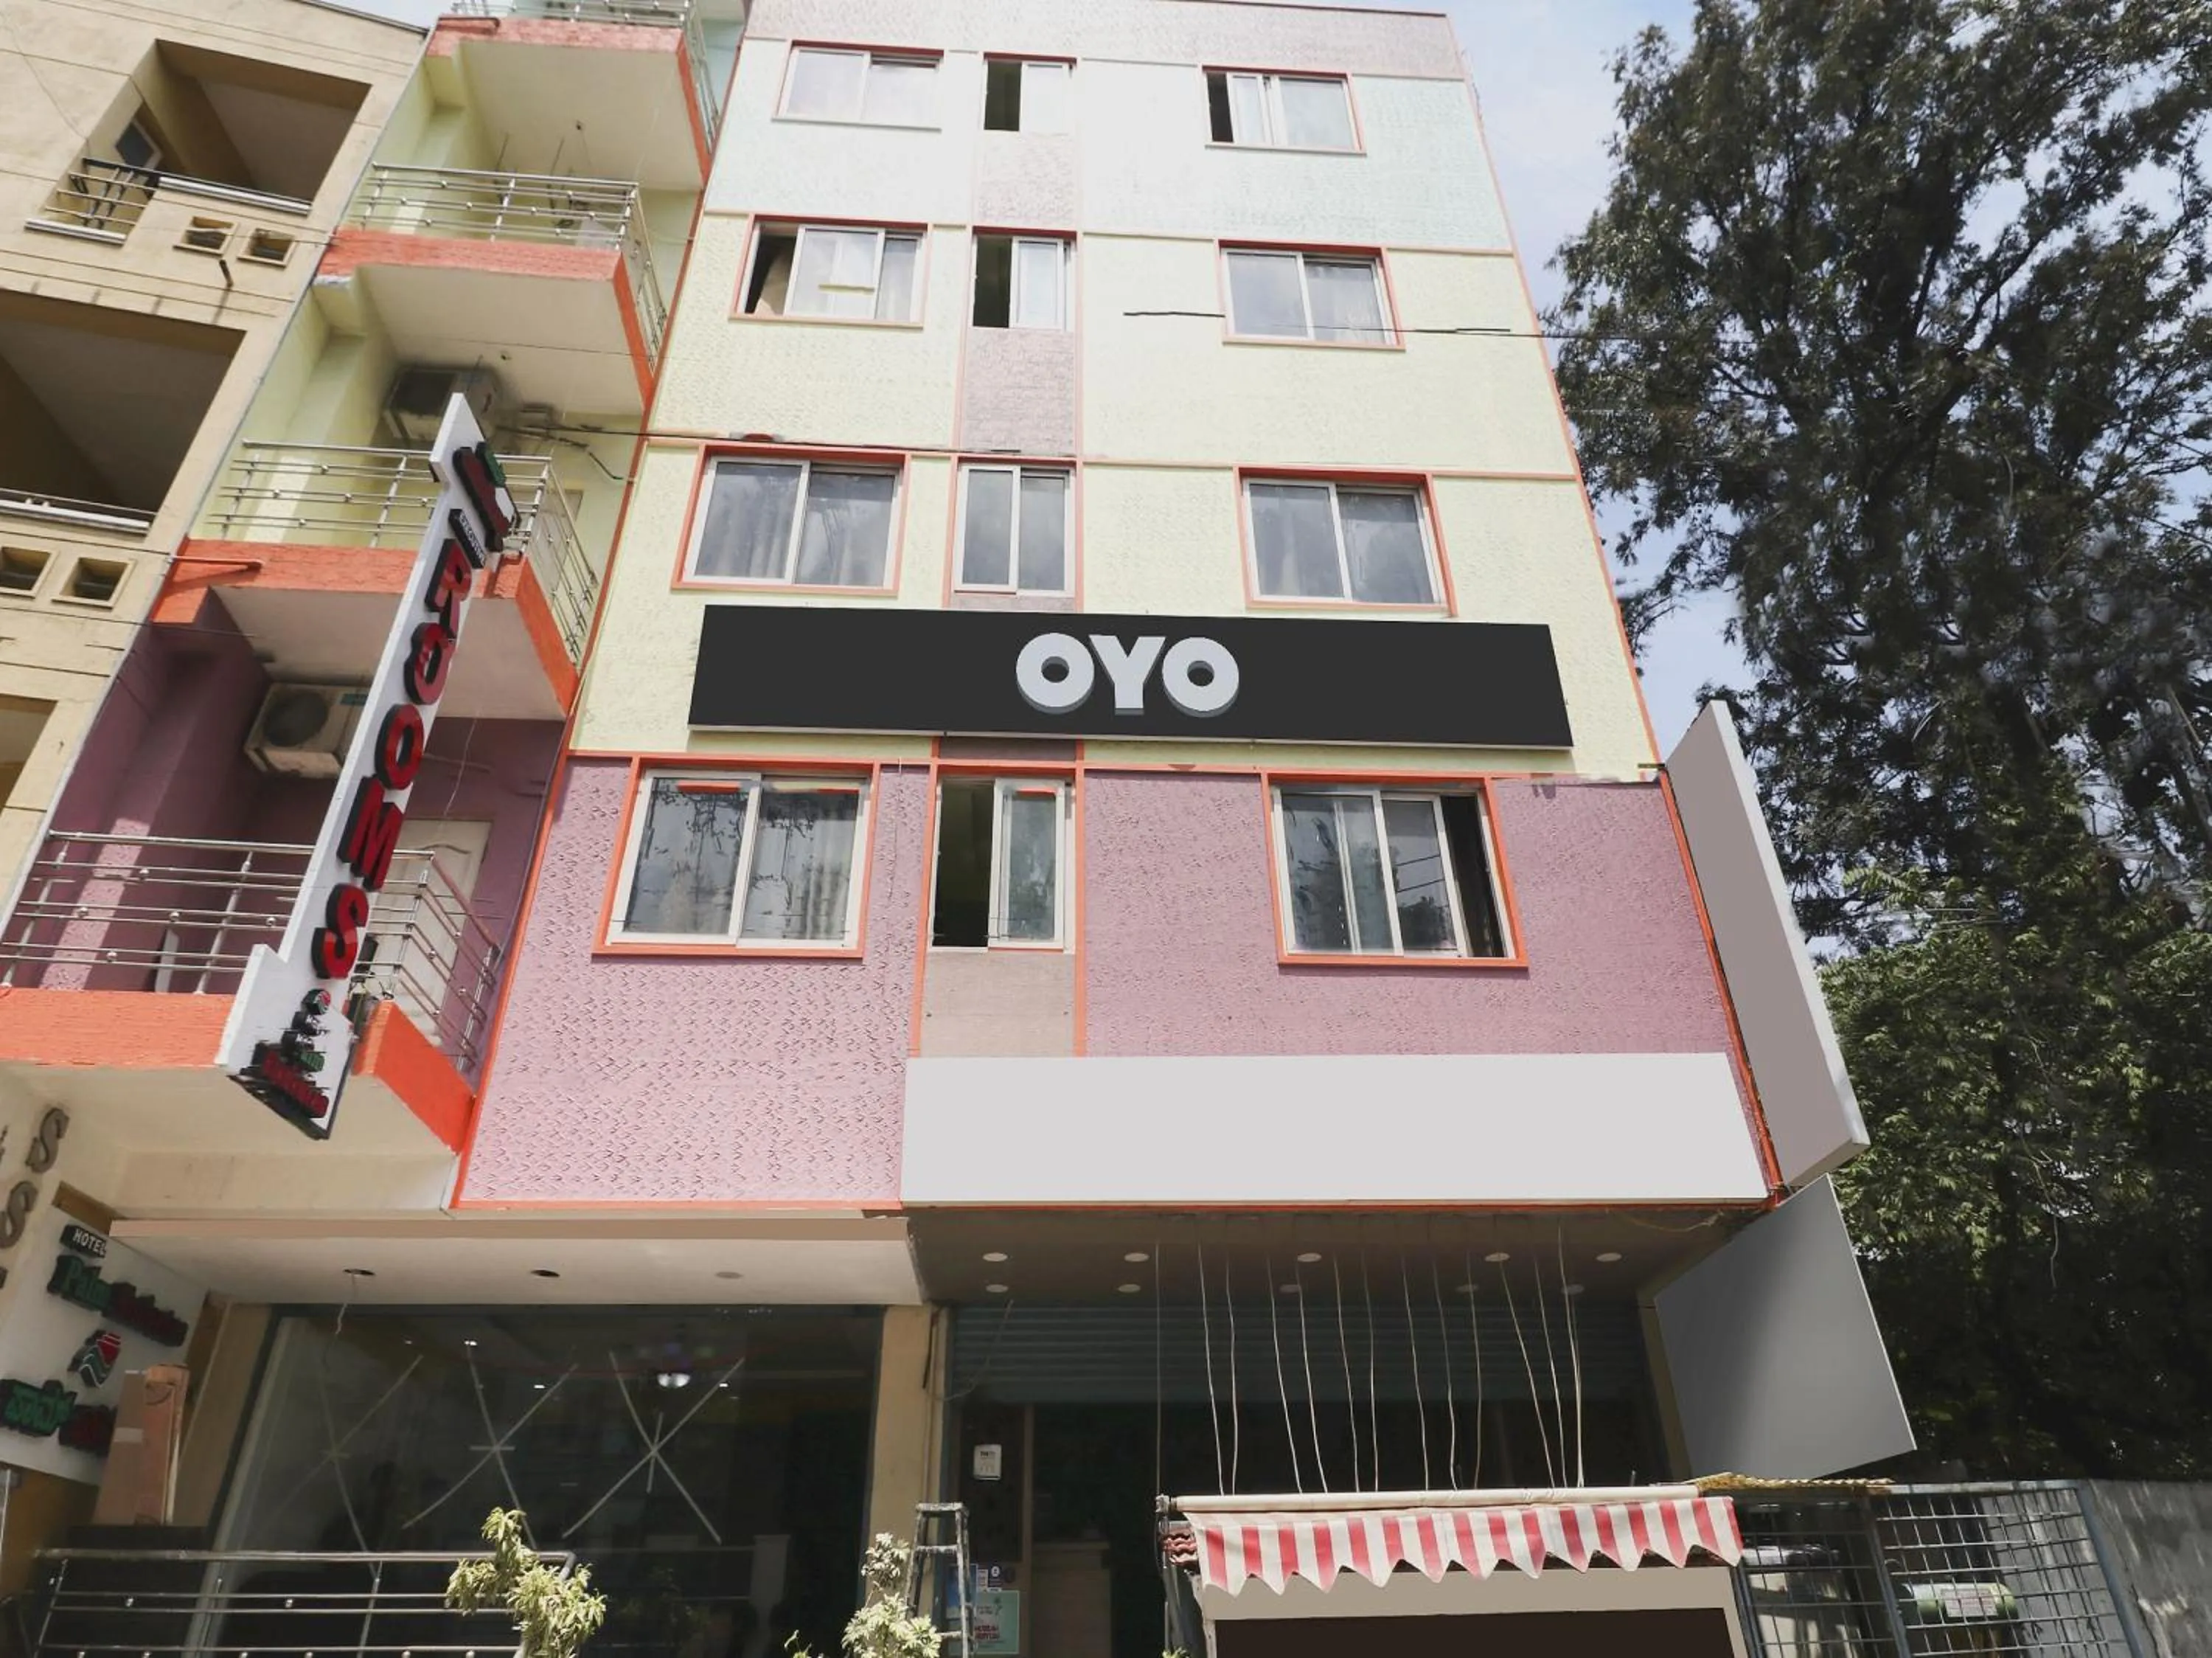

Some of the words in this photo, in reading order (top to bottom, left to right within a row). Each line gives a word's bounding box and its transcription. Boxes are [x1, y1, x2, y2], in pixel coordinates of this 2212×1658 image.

[1015, 632, 1240, 718] OYO
[313, 538, 473, 979] ROOMS
[72, 1227, 107, 1258] HOTEL
